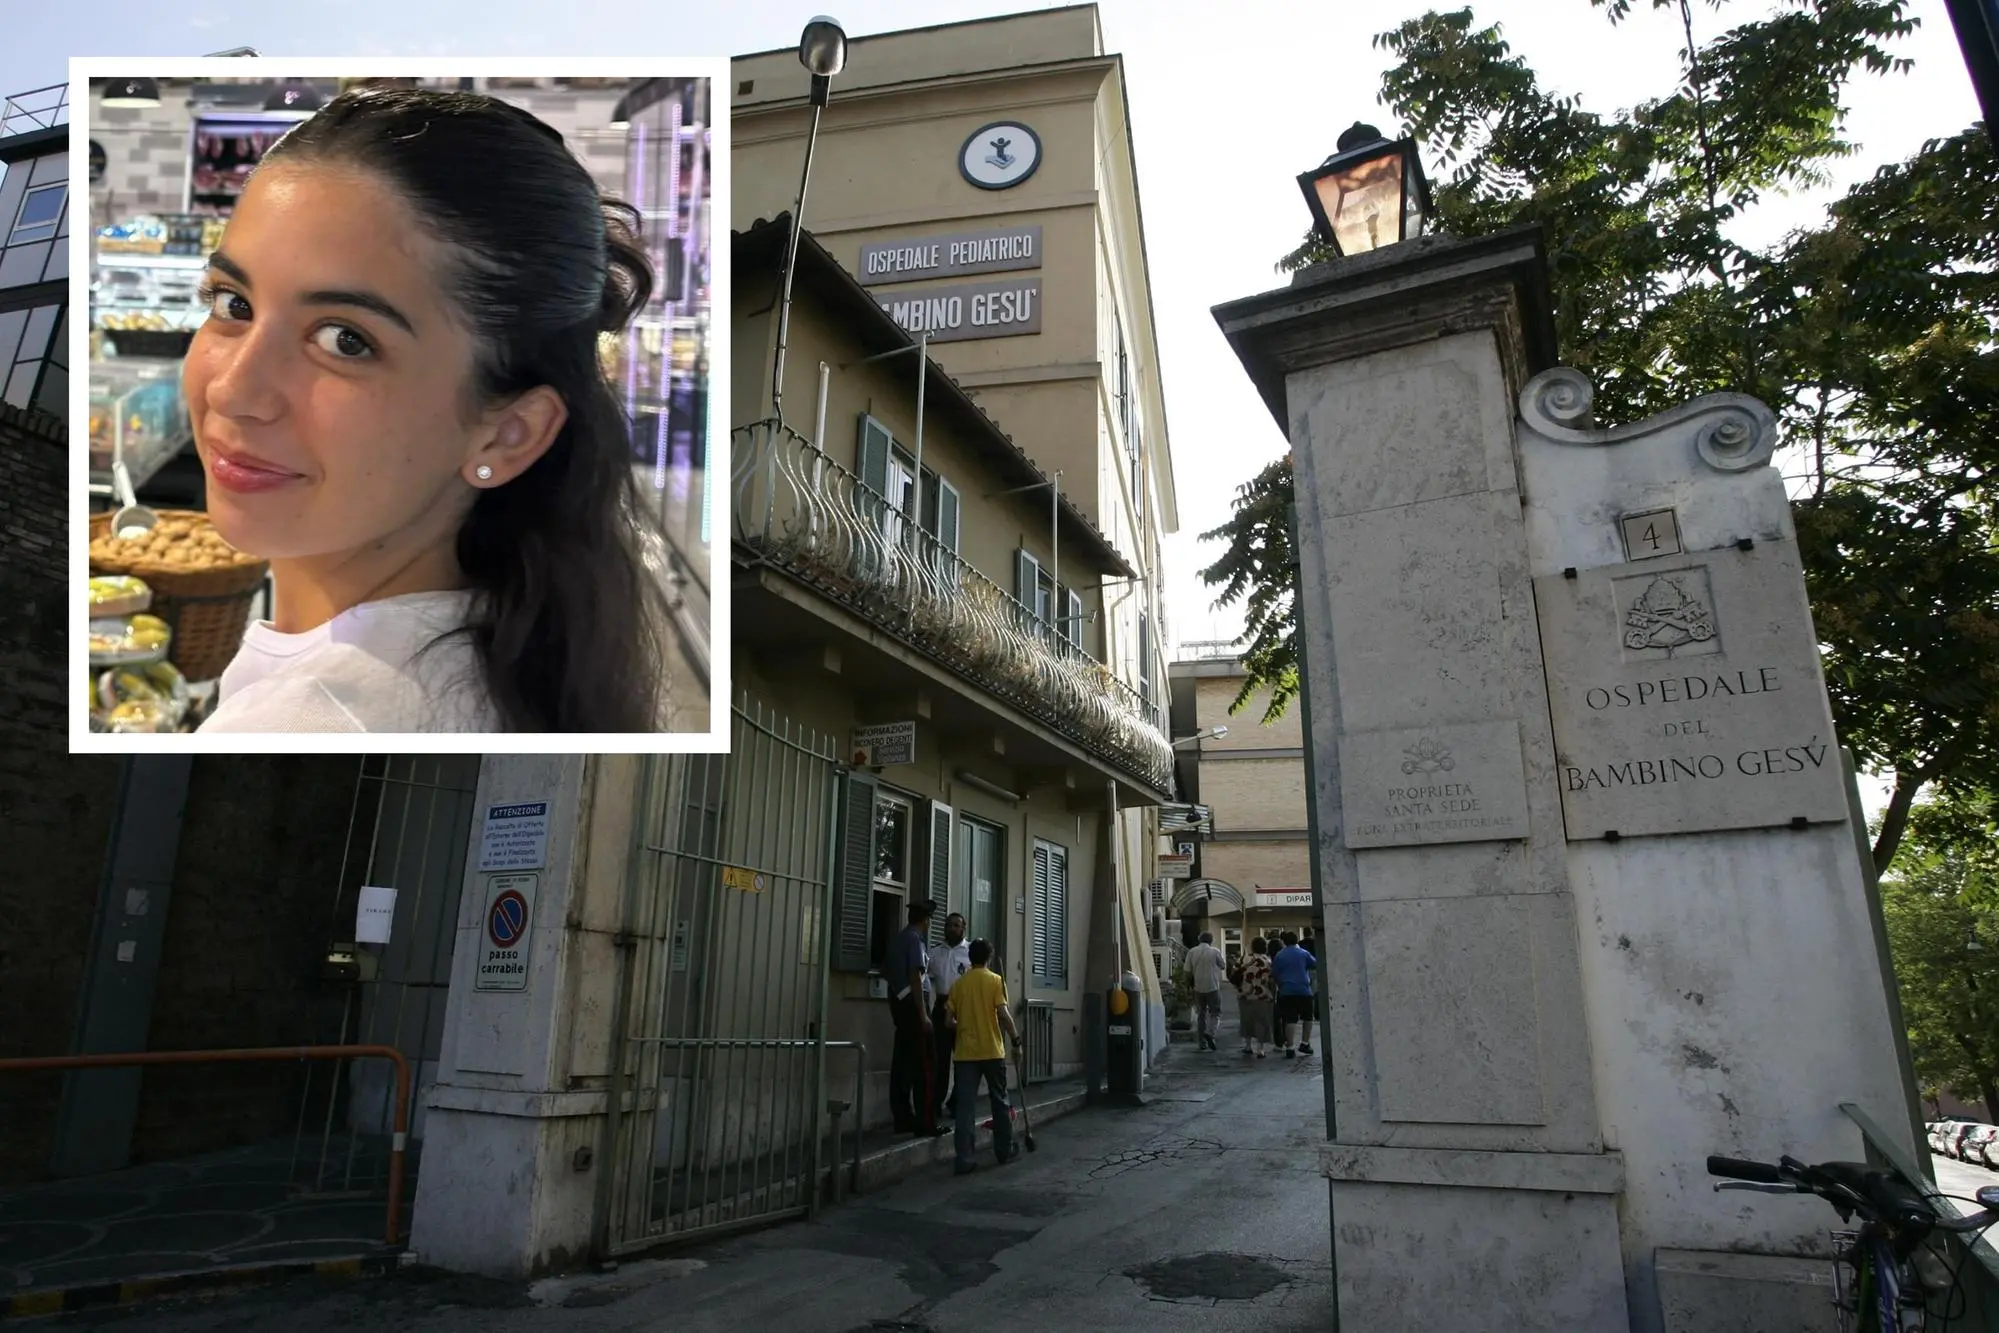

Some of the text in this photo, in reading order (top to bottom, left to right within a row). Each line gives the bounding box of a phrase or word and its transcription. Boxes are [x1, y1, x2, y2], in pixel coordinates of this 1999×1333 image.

[868, 234, 1032, 274] OSPEDALE PEDIATRICO
[881, 296, 962, 332] MBINO
[1641, 522, 1661, 550] 4
[1585, 667, 1782, 711] OSPEDALE
[1663, 719, 1709, 737] DEL
[1566, 754, 1725, 792] BAMBINO
[493, 805, 542, 817] ATTENZIONE
[1384, 798, 1482, 818] SANTA SEDE
[489, 950, 518, 961] passo
[481, 963, 524, 974] carrabile
